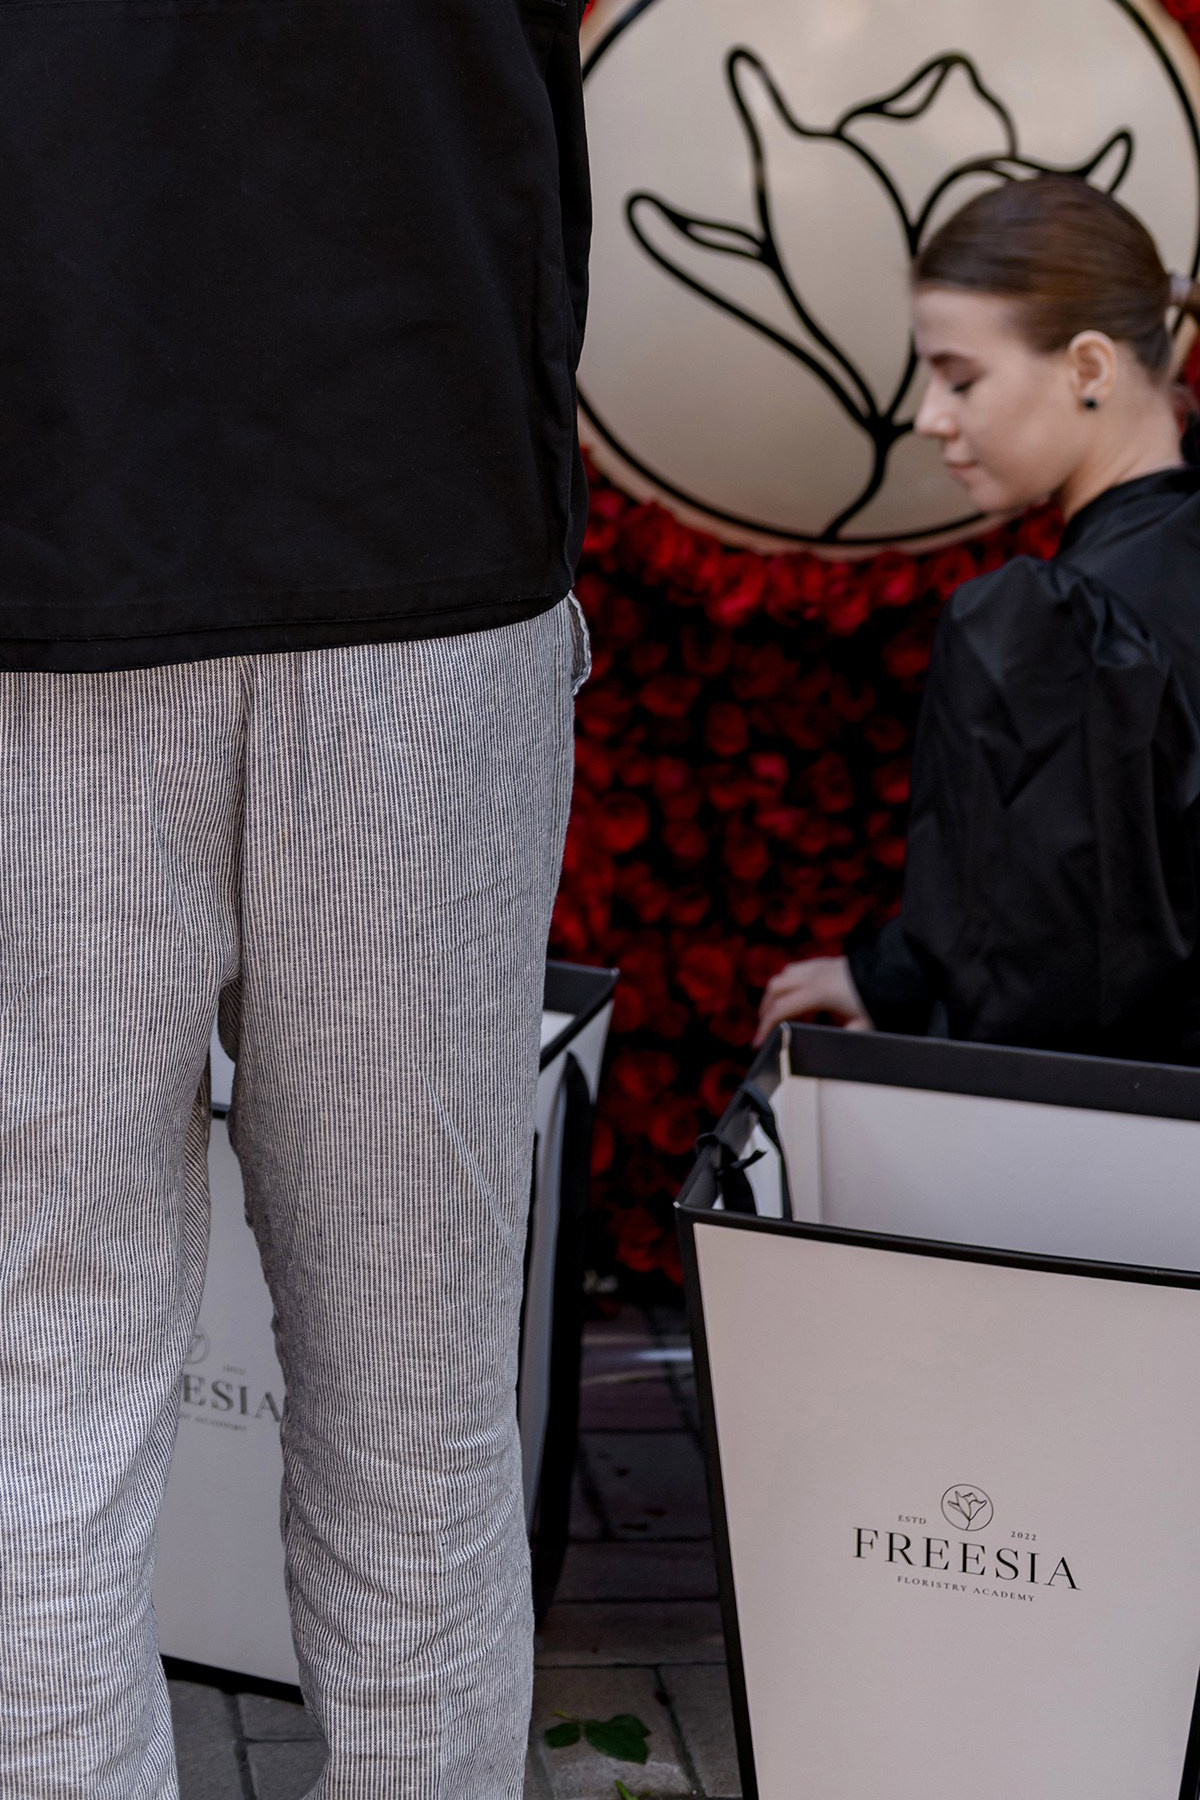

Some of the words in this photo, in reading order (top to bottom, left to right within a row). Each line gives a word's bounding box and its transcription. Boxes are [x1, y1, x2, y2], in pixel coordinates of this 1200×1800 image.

[182, 1373, 282, 1423] ESIA
[897, 1514, 927, 1526] ESTD
[1010, 1530, 1037, 1542] 2022
[852, 1526, 1081, 1591] FREESIA
[897, 1575, 967, 1593] FLORISTRY
[973, 1587, 1036, 1602] ACADEMY
